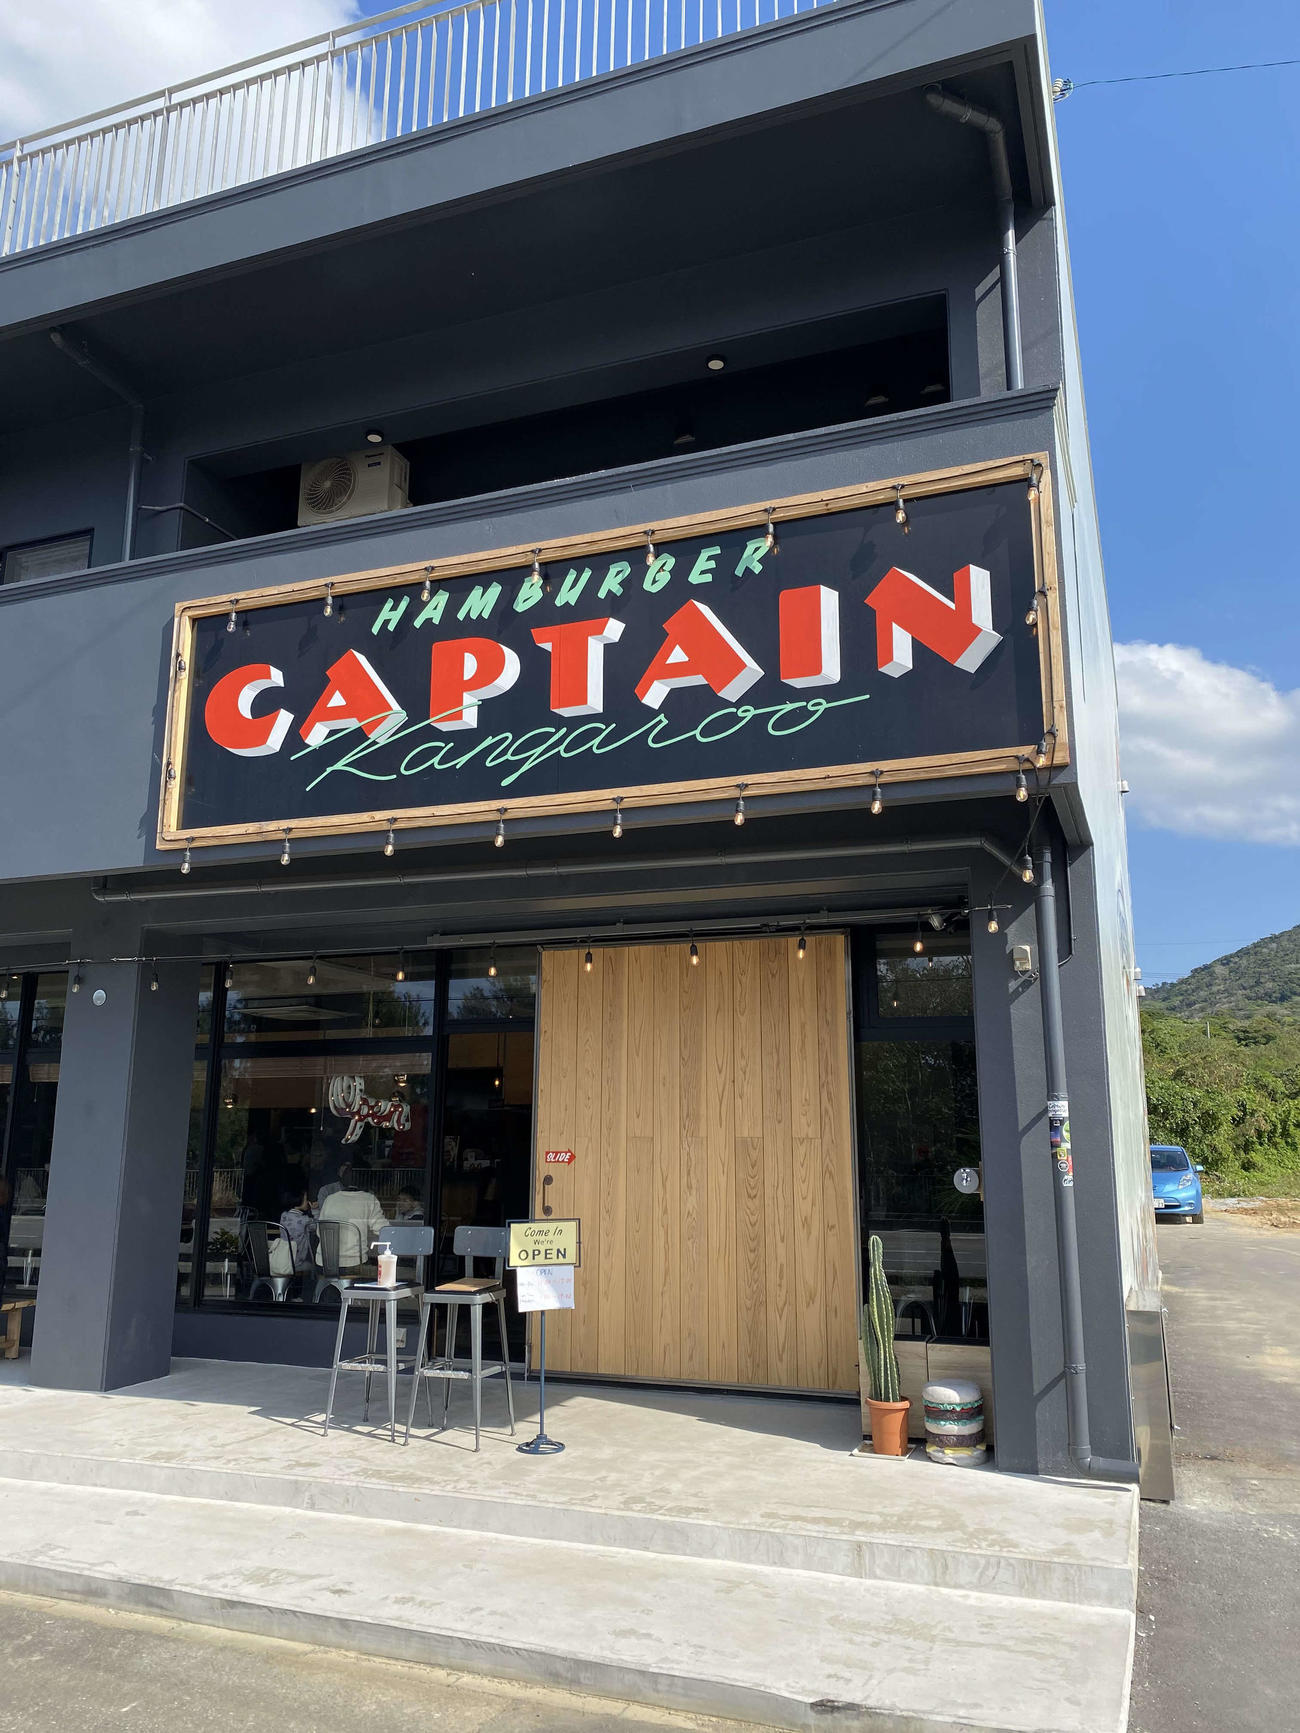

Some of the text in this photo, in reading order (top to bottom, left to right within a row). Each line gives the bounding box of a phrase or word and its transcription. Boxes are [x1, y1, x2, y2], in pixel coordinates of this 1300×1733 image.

[371, 537, 774, 636] HAMBURGER
[204, 561, 1004, 757] CAPTAIN
[289, 693, 871, 792] Kangaroo
[546, 1152, 572, 1163] SLIDE
[524, 1226, 563, 1238] Come In
[533, 1238, 554, 1246] We're
[518, 1247, 567, 1262] OPEN
